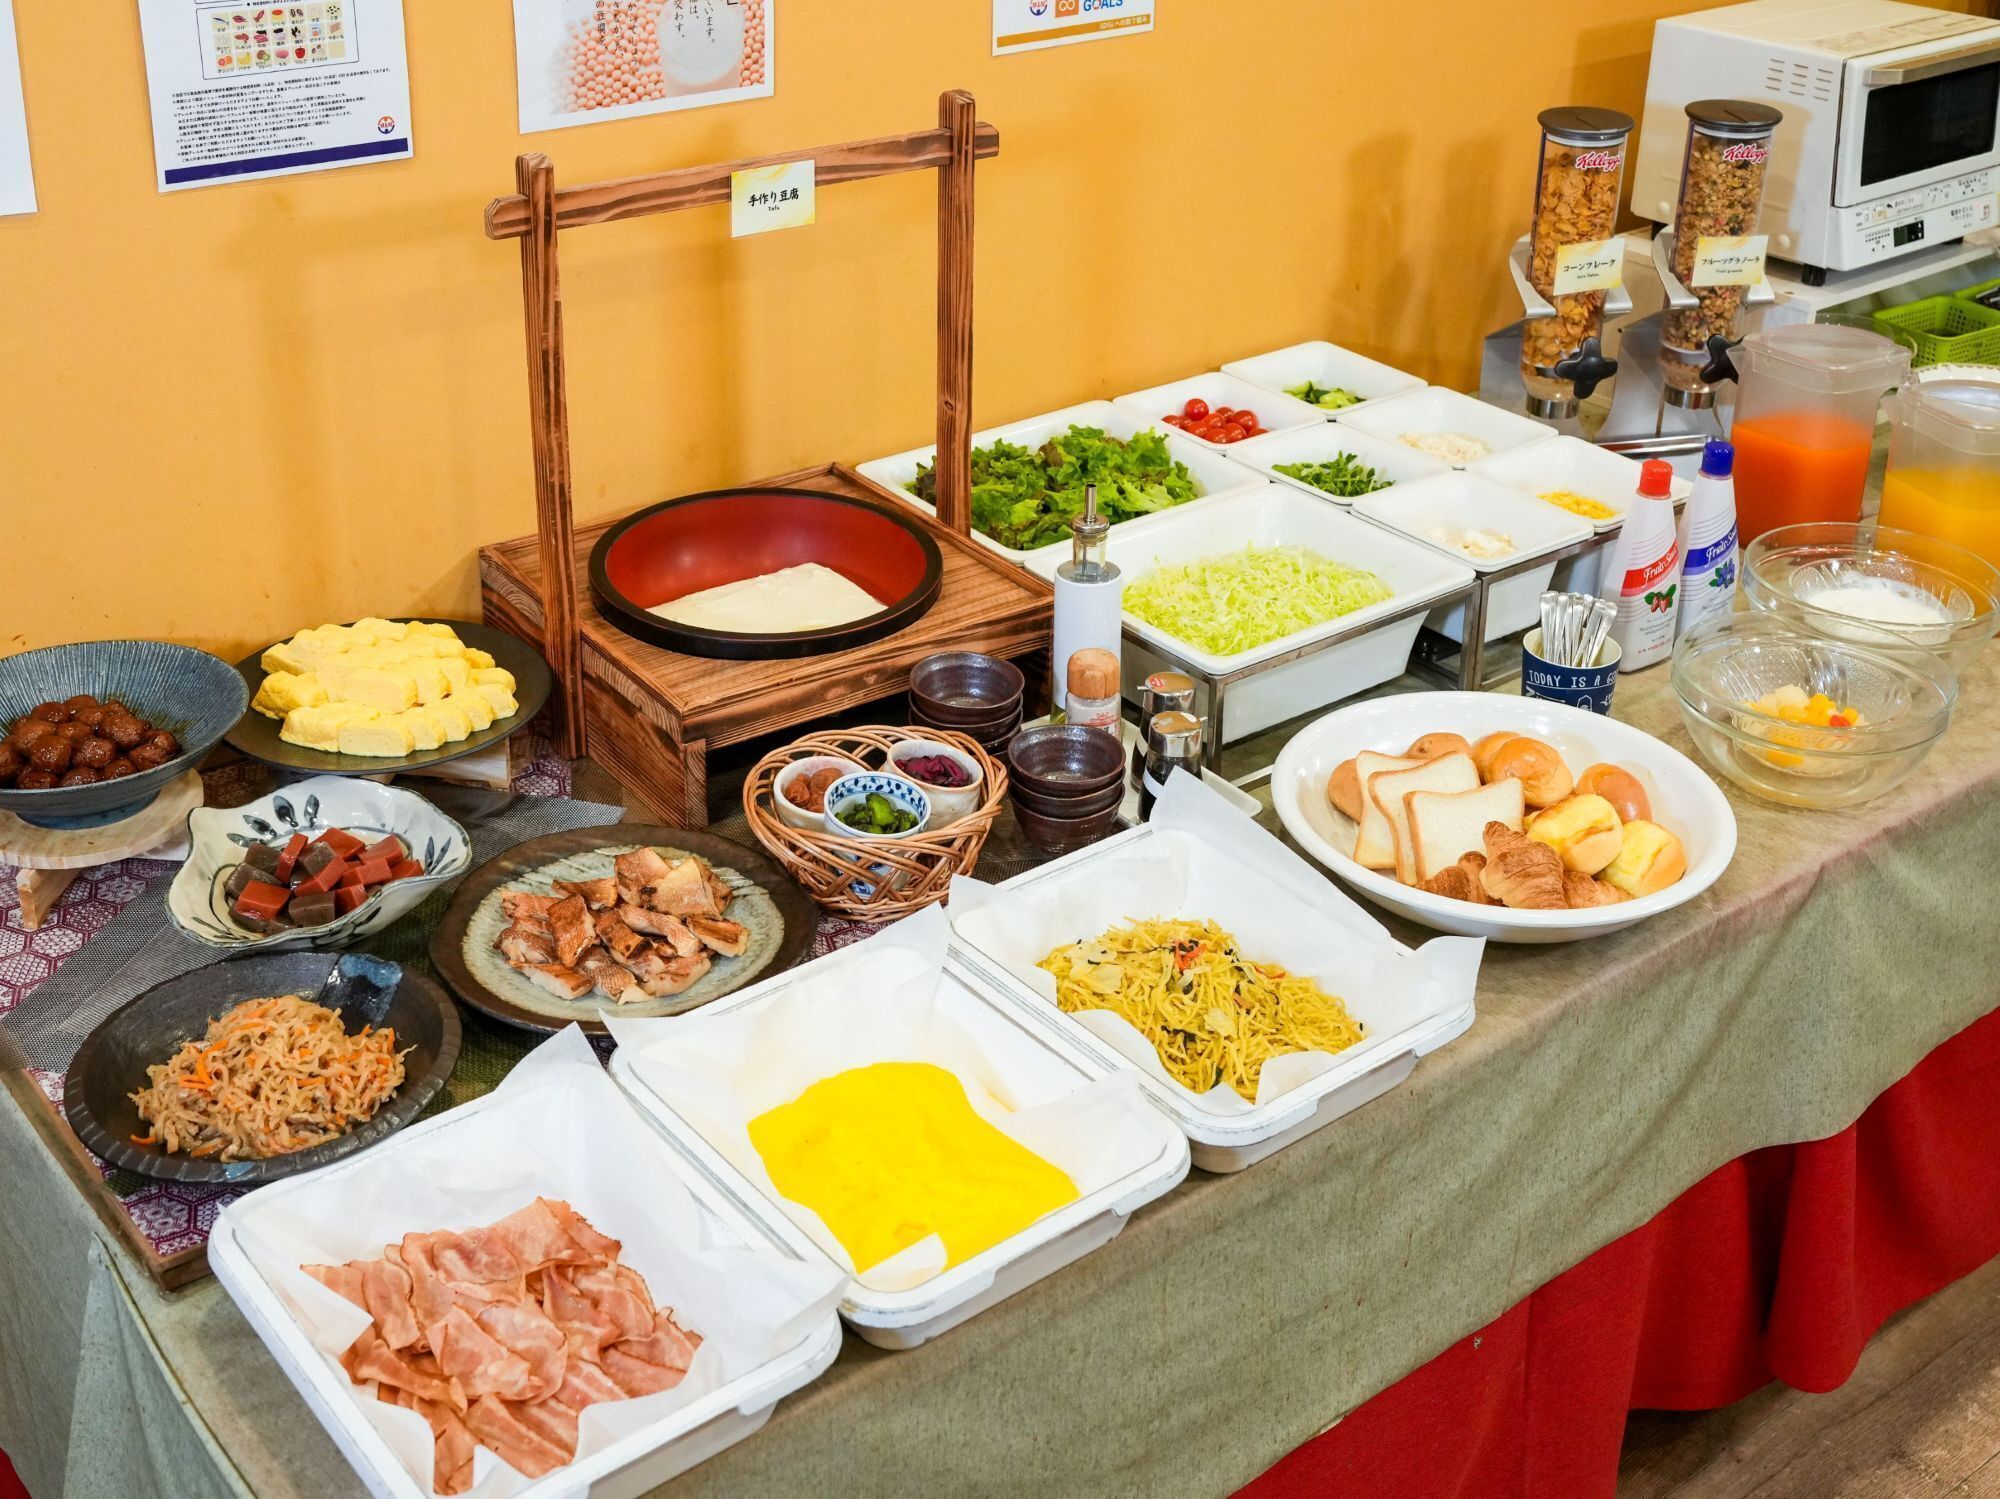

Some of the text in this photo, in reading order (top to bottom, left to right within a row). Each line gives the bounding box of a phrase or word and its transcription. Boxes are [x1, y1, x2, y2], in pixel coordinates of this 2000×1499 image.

[748, 188, 799, 207] 手作り豆腐
[1563, 259, 1616, 272] コーンフレーク
[1702, 256, 1760, 265] フルーツグラノーラ
[1704, 540, 1727, 567] Fruits
[1642, 560, 1667, 588] Fruits
[1529, 670, 1561, 687] TODAY
[1571, 676, 1586, 688] IS
[1593, 674, 1601, 686] A
